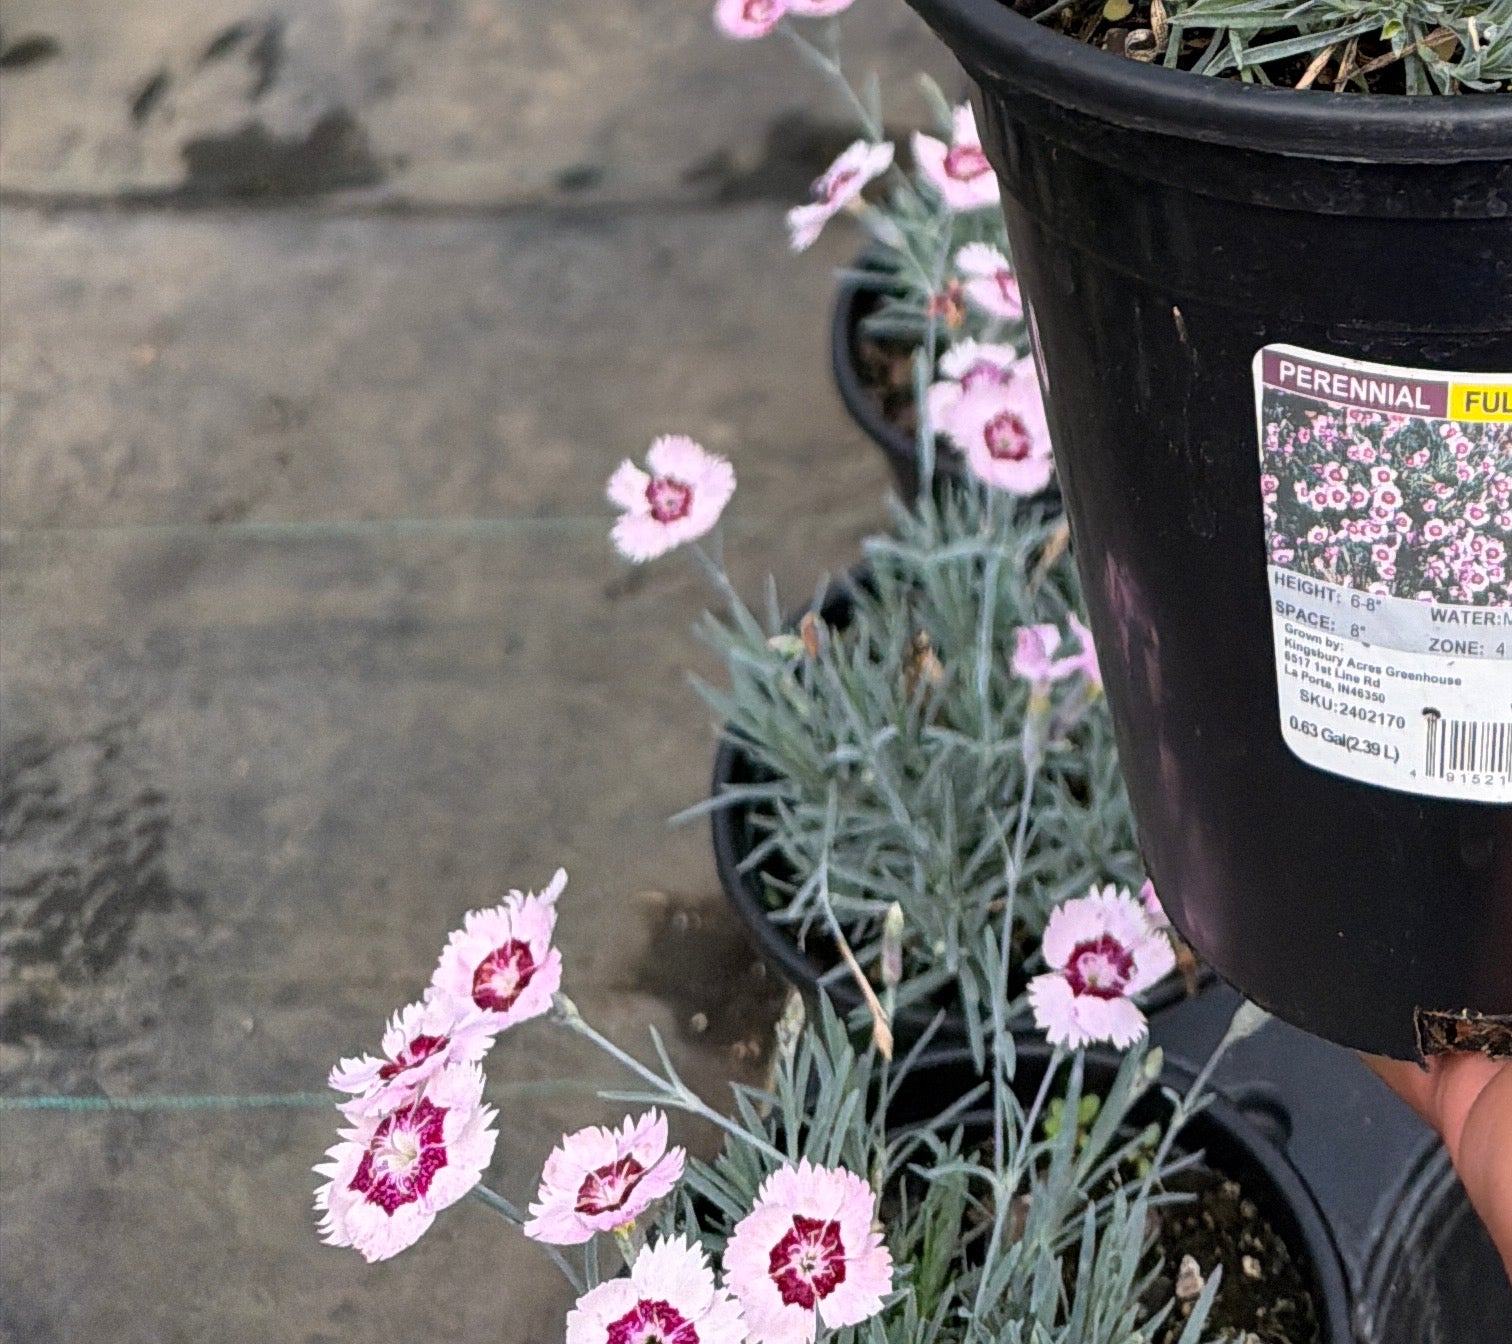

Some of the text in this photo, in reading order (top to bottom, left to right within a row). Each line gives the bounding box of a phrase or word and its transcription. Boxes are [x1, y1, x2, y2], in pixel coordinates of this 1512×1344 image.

[1279, 359, 1431, 411] PERENNIAL
[1274, 571, 1382, 612] HEIGHT: 6-8"
[1275, 600, 1335, 631] SPACE:
[1430, 608, 1501, 626] WATER:
[1284, 622, 1344, 652] Grown by:
[1429, 637, 1505, 657] ZONE: 4
[1284, 636, 1462, 686] Kingsbury Acres Greenhouse
[1315, 662, 1332, 676] 1st
[1335, 668, 1360, 683] Line
[1363, 675, 1381, 688] Rd
[1284, 663, 1385, 703] La Porte, IN46350
[1299, 689, 1406, 729] SKU:2402170
[1289, 715, 1318, 738] 0.63
